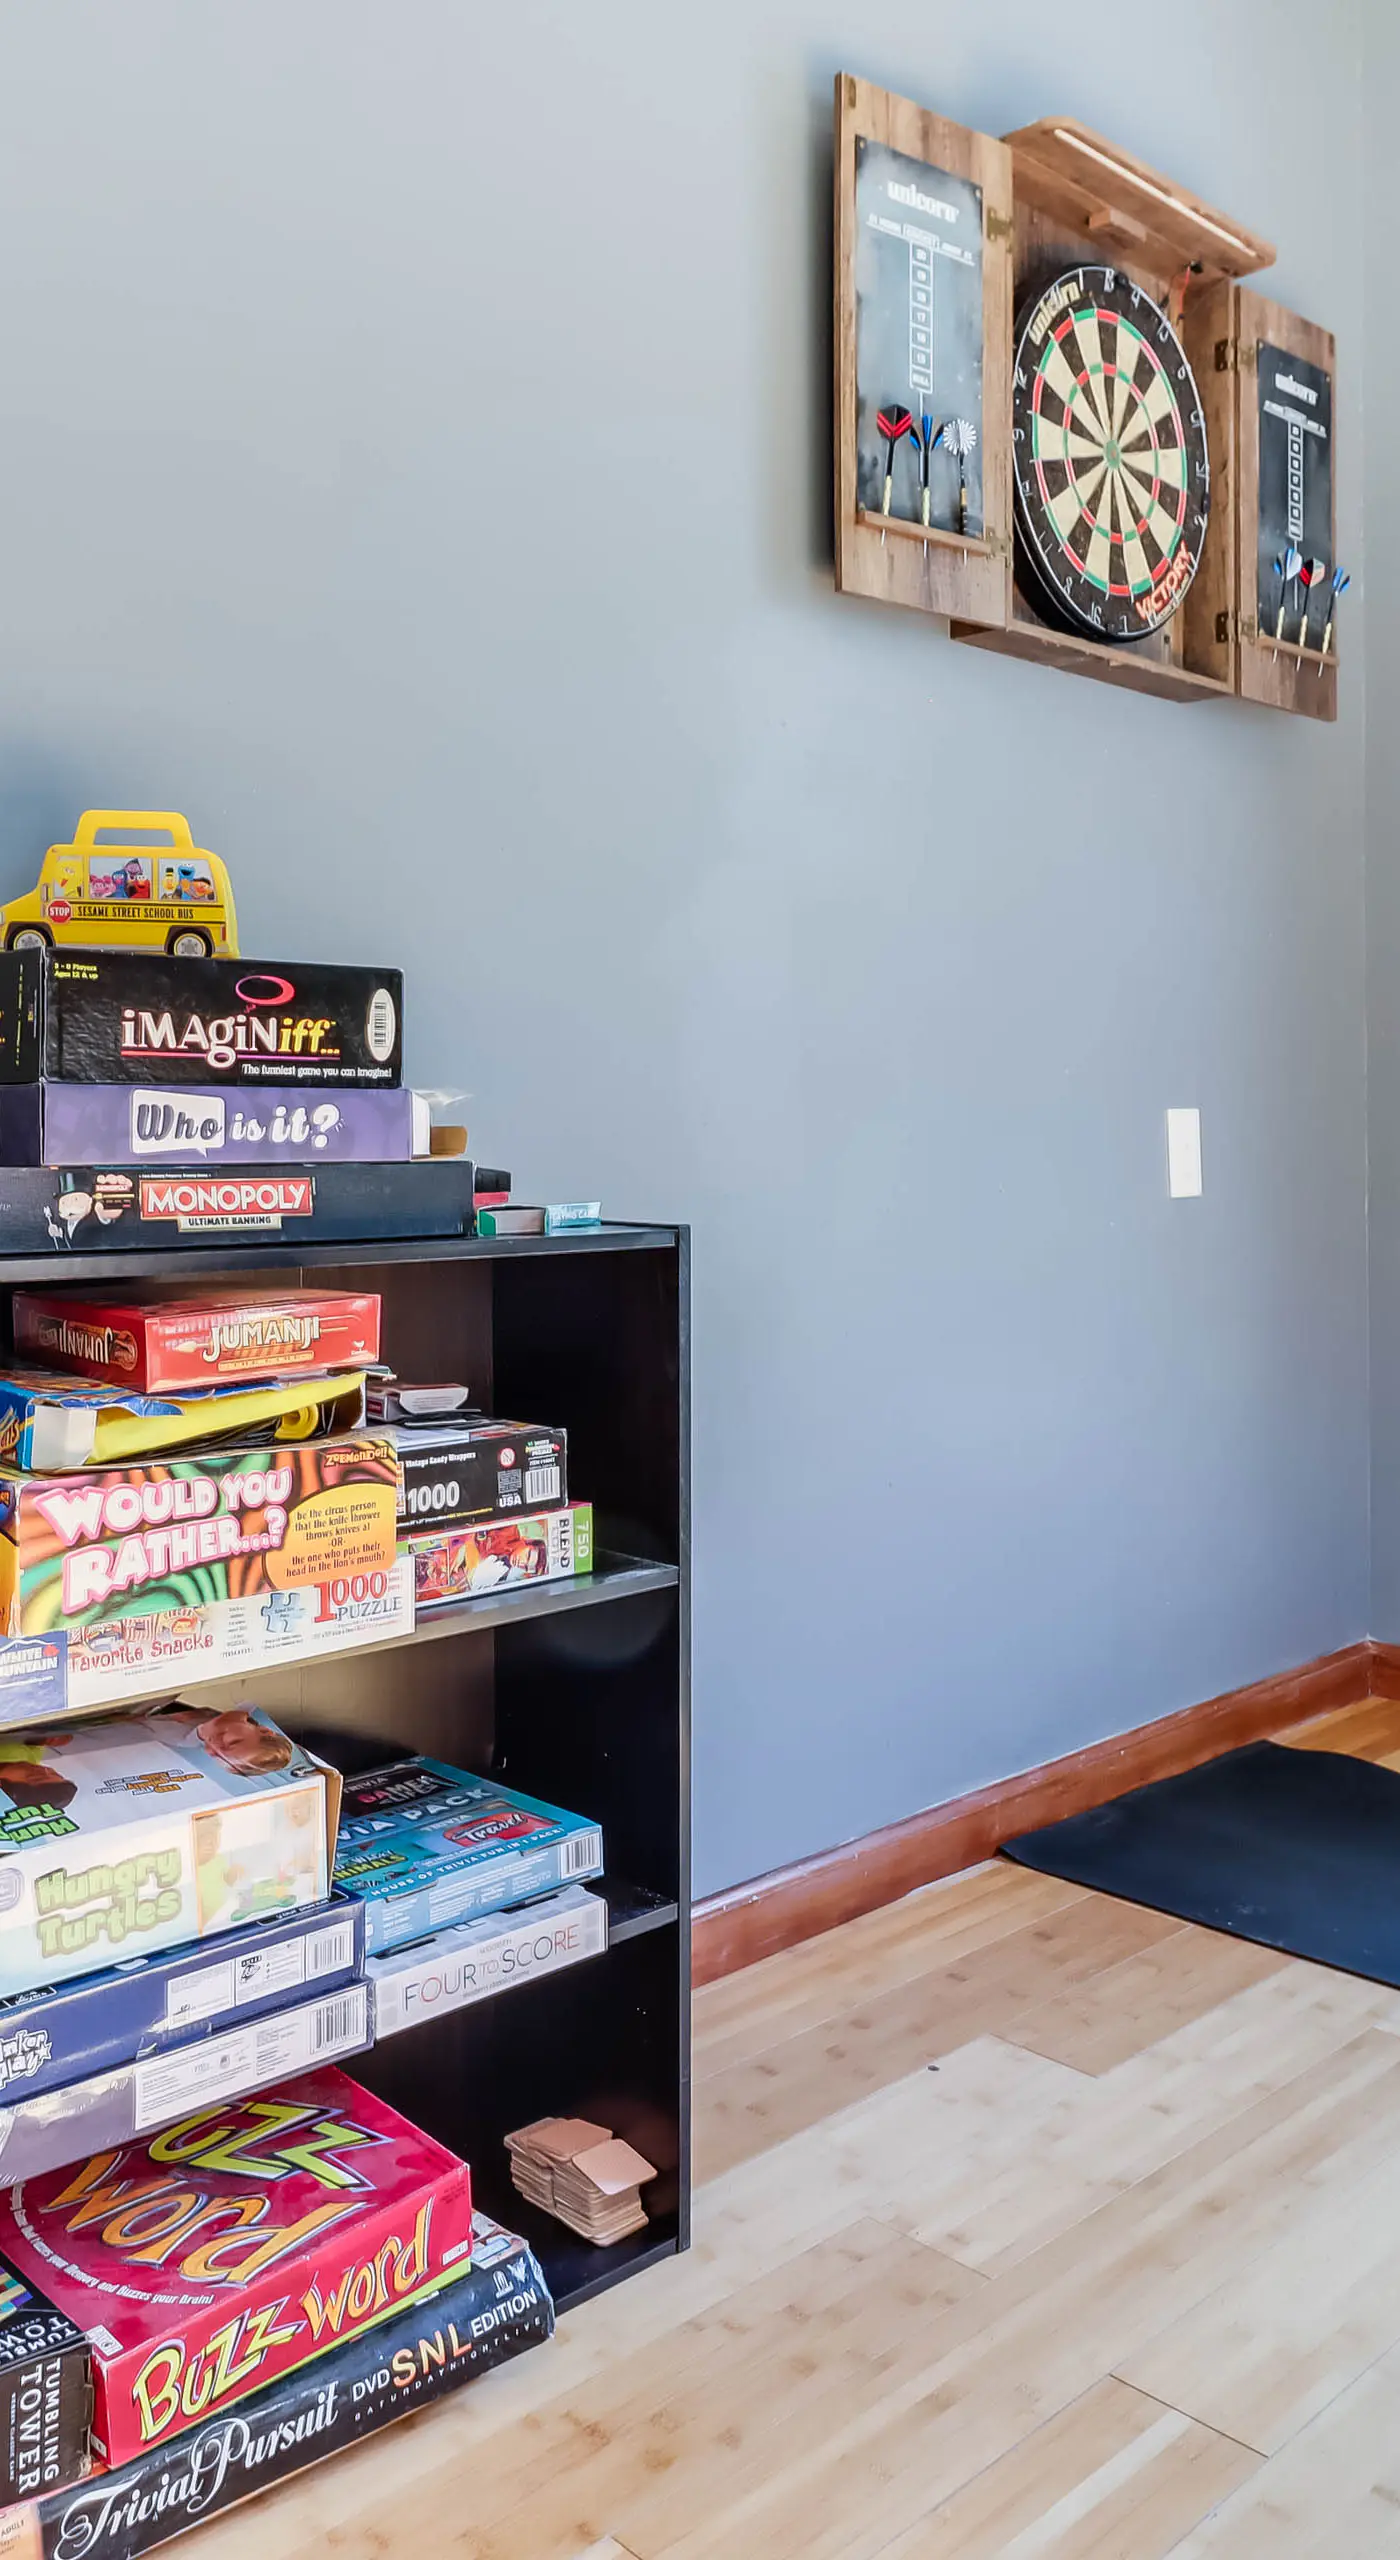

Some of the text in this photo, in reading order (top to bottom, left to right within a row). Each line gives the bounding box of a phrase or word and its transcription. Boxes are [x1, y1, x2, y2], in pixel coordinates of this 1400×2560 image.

[887, 179, 960, 224] unicorn
[1134, 539, 1192, 622] VICTORY
[49, 906, 70, 917] STOP
[77, 905, 194, 919] SESAME STREET SCHOOL BUS
[241, 1064, 393, 1080] The funniest game you can imagine!
[136, 1102, 341, 1150] Who is it?
[147, 1183, 306, 1213] MONOPOLY
[188, 1215, 272, 1227] ULTIMATE BANKING
[58, 1319, 114, 1365] JUMANJI
[202, 1315, 321, 1363] JUMANJI
[34, 1465, 293, 1548] WOULD YOU
[296, 1501, 377, 1521] be the circus person
[407, 1480, 460, 1514] 1000
[499, 1494, 522, 1508] USA
[295, 1511, 381, 1533] that the knife thrower
[305, 1522, 371, 1542] throws knives at
[576, 1520, 590, 1558] 750
[285, 1550, 387, 1578] head in the lion's mouth?
[291, 1541, 381, 1566] the one who puts their
[559, 1518, 570, 1569] BLEND
[313, 1571, 389, 1624] 1000
[336, 1596, 403, 1622] PUZZLE
[68, 1646, 145, 1674] Favorite
[149, 1633, 215, 1660] Snacks
[400, 1788, 493, 1821] PACK
[419, 1814, 474, 1833] TRIVIA
[451, 1810, 529, 1845] Travel
[34, 1847, 182, 1916] Hungry
[370, 1875, 415, 1897] HOURS
[417, 1868, 436, 1882] OF
[437, 1854, 480, 1874] TRIVIA
[480, 1845, 507, 1860] FUN
[507, 1840, 522, 1852] IN
[37, 1887, 182, 1959] Turtles
[404, 1923, 582, 2012] FOUR TO SCORE
[63, 2263, 100, 2289] Memory
[97, 2281, 120, 2294] and
[116, 2284, 153, 2301] Buzzes
[150, 2294, 179, 2305] your
[178, 2293, 215, 2305] Brain!
[352, 2287, 538, 2403] DVD SNL EDITION
[353, 2316, 542, 2423] SATURDAY NIGHT LIVE
[17, 2362, 43, 2495] TOWER
[43, 2356, 61, 2482] TUMBLING
[53, 2382, 339, 2560] Trivial Pursuit
